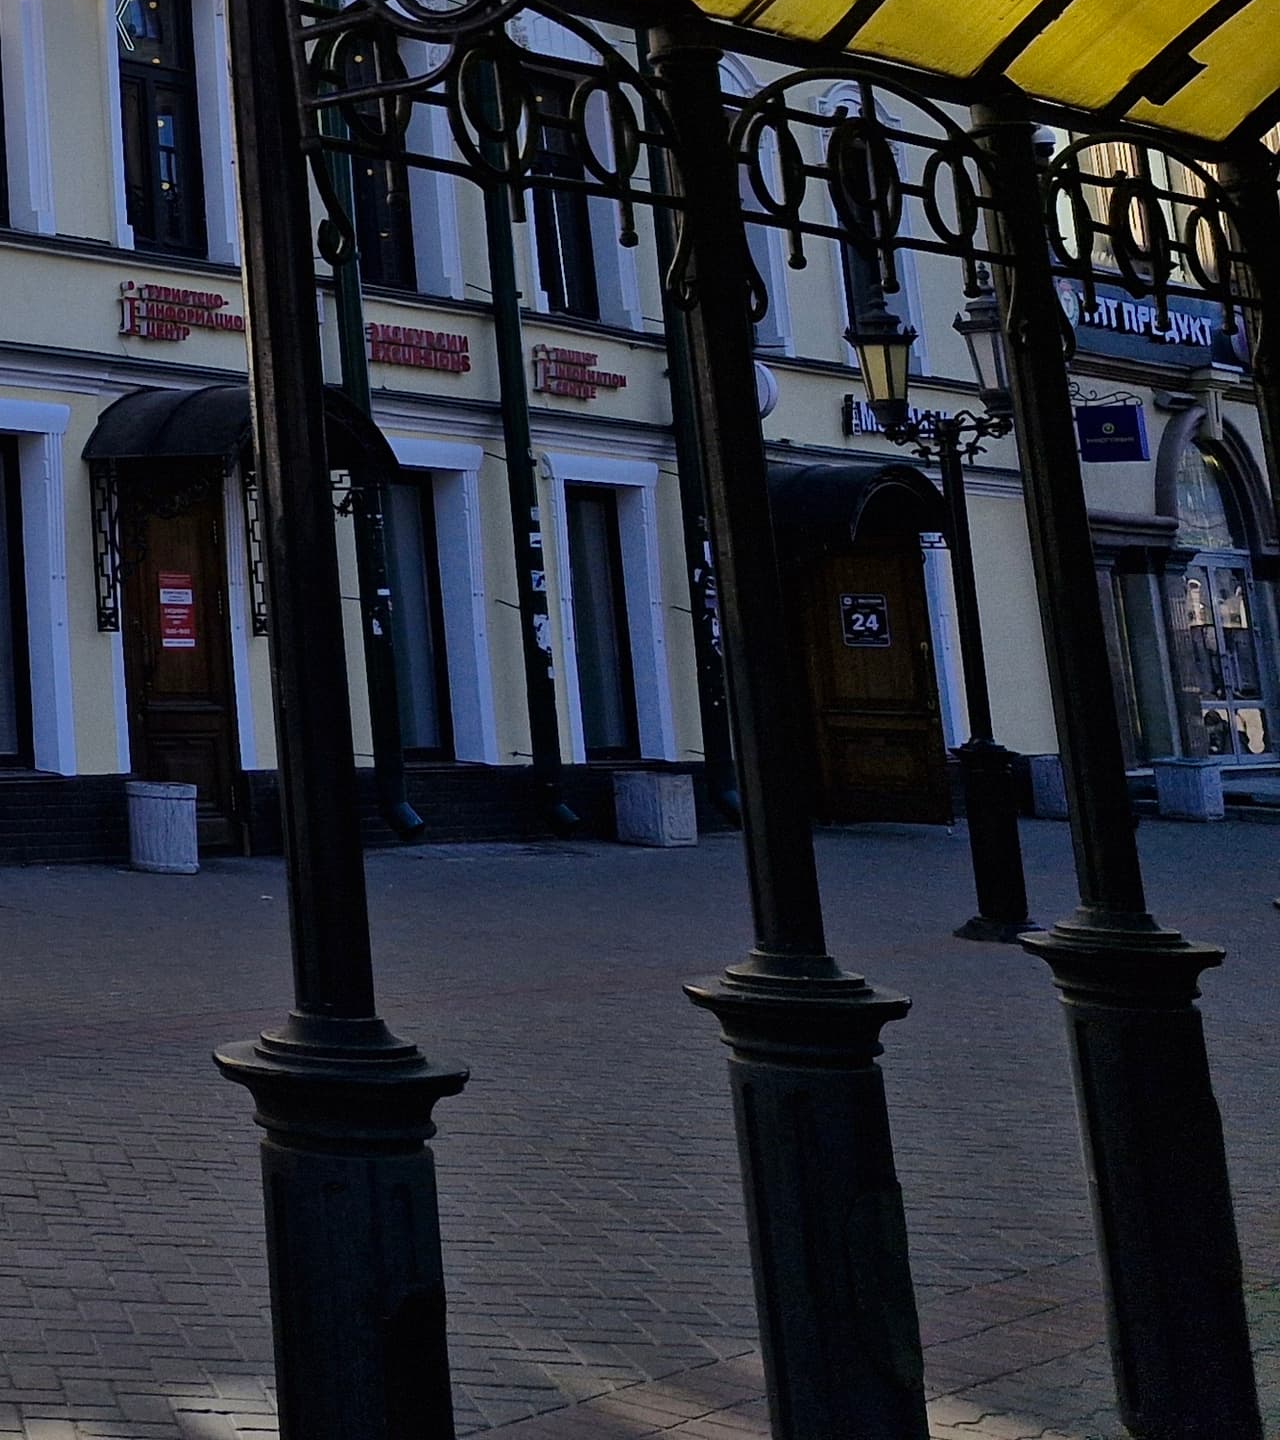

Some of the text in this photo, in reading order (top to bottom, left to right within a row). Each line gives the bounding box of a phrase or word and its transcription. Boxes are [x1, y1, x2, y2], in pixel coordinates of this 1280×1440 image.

[143, 302, 246, 332] ИНФОРМАЦИО
[143, 321, 191, 341] ЦЕНТР
[851, 613, 880, 631] 24
